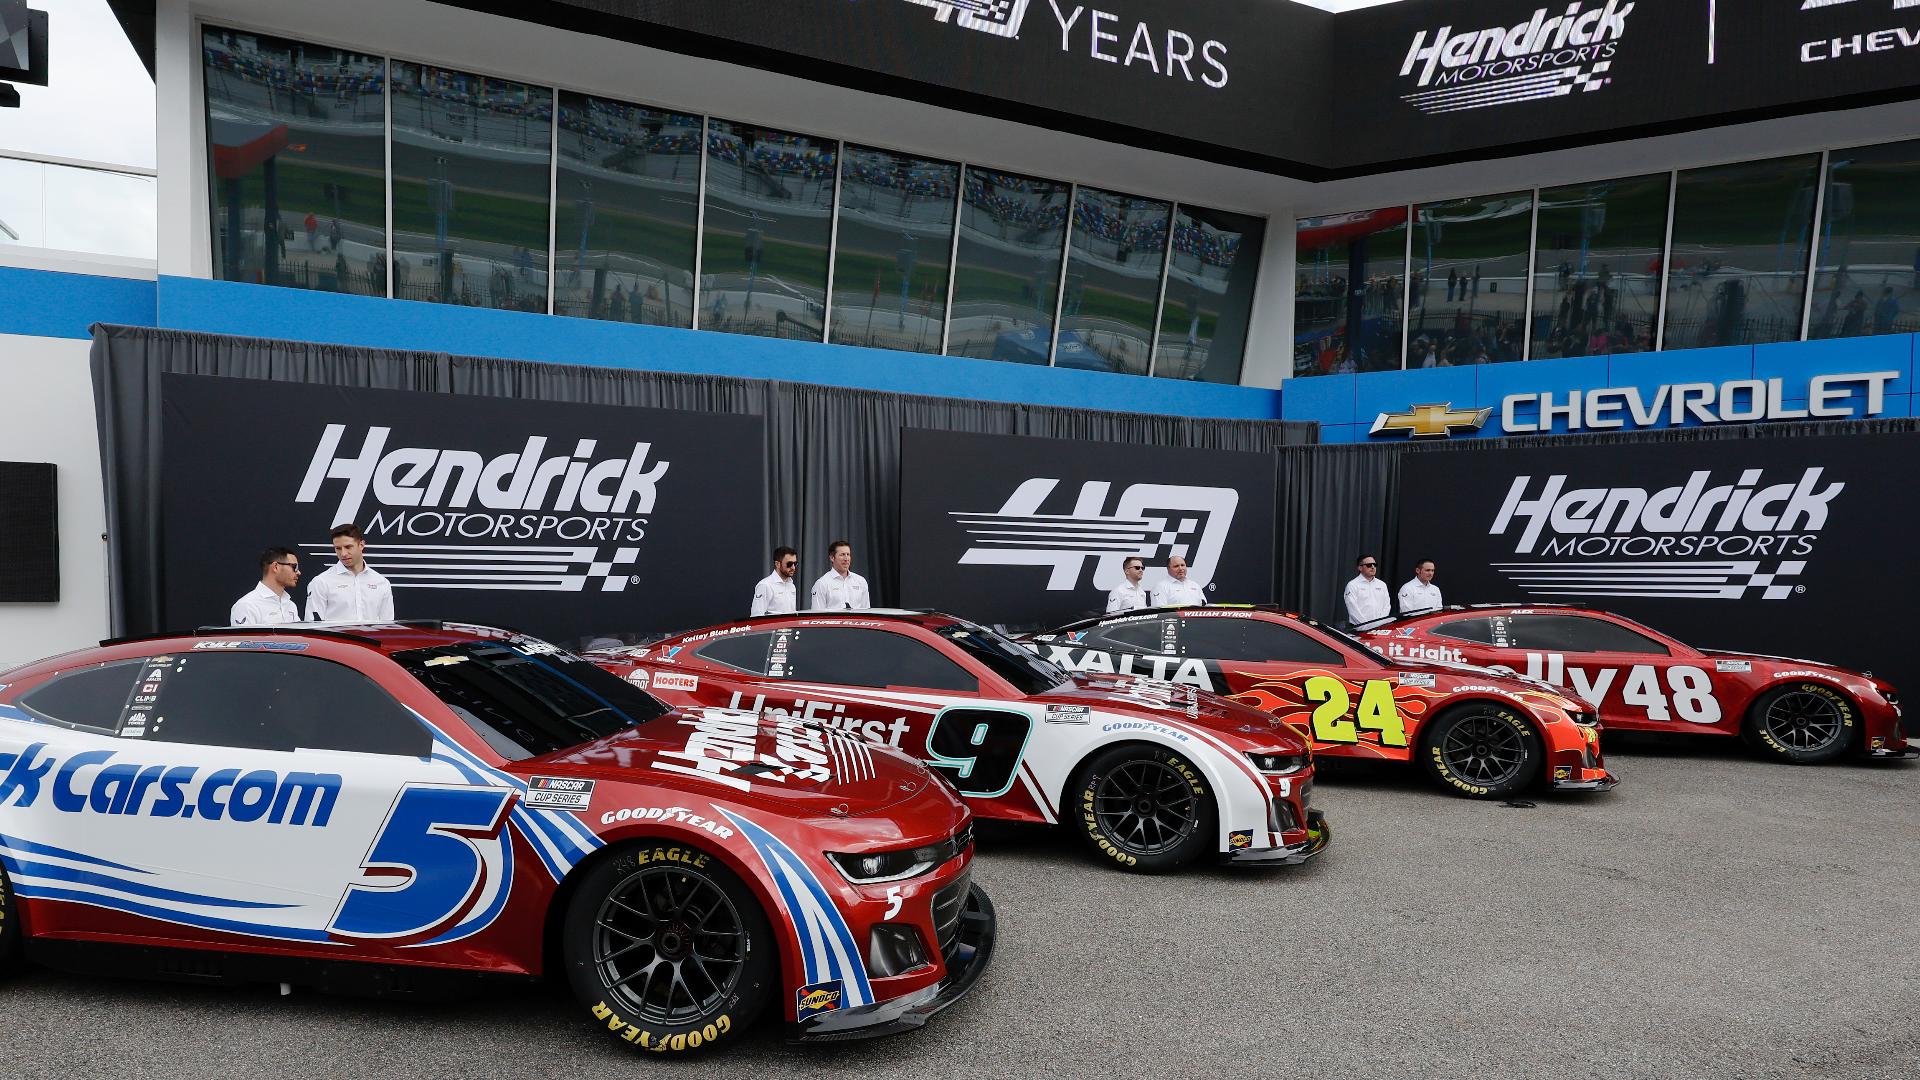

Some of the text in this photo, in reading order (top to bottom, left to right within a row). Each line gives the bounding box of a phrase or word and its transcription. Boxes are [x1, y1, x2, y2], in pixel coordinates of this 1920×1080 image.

[1046, 0, 1229, 89] YEARS
[1399, 0, 1636, 87] Hendrick
[1435, 42, 1618, 87] MOTORSPORTS
[1502, 370, 1900, 435] CHEVROLET
[295, 423, 670, 530] Hendrick
[364, 509, 648, 542] MOTORSPORTS
[1489, 466, 1845, 554] Hendrick
[950, 477, 1240, 591] 40
[1541, 534, 1818, 557] MOTORSPORTS
[709, 629, 729, 639] Blue
[729, 624, 752, 634] Book
[1184, 610, 1220, 618] WILLIAM
[1364, 641, 1468, 663] o it right.
[654, 674, 695, 688] HOOTERS
[1486, 653, 1722, 724] lly 48
[729, 691, 911, 752] UiFirst
[1305, 676, 1408, 747] 24
[1497, 711, 1532, 737] EAGLE
[1102, 721, 1190, 743] GOODYEAR
[1759, 729, 1788, 753] EAGLE
[926, 705, 1034, 798] 9
[548, 779, 586, 791] NASCAR
[1167, 757, 1204, 795] EAGLE
[1279, 777, 1291, 798] 9
[1431, 746, 1488, 795] GOODYEAR
[534, 793, 582, 804] CUP SERIES
[601, 806, 734, 841] GOODYEAR
[1083, 790, 1137, 867] GOODYEAR
[323, 781, 520, 940] 5
[638, 847, 711, 869] EAGLE
[884, 885, 903, 921] 5
[799, 990, 840, 1011] SUNOCO
[592, 1000, 731, 1052] GOODYEAR
